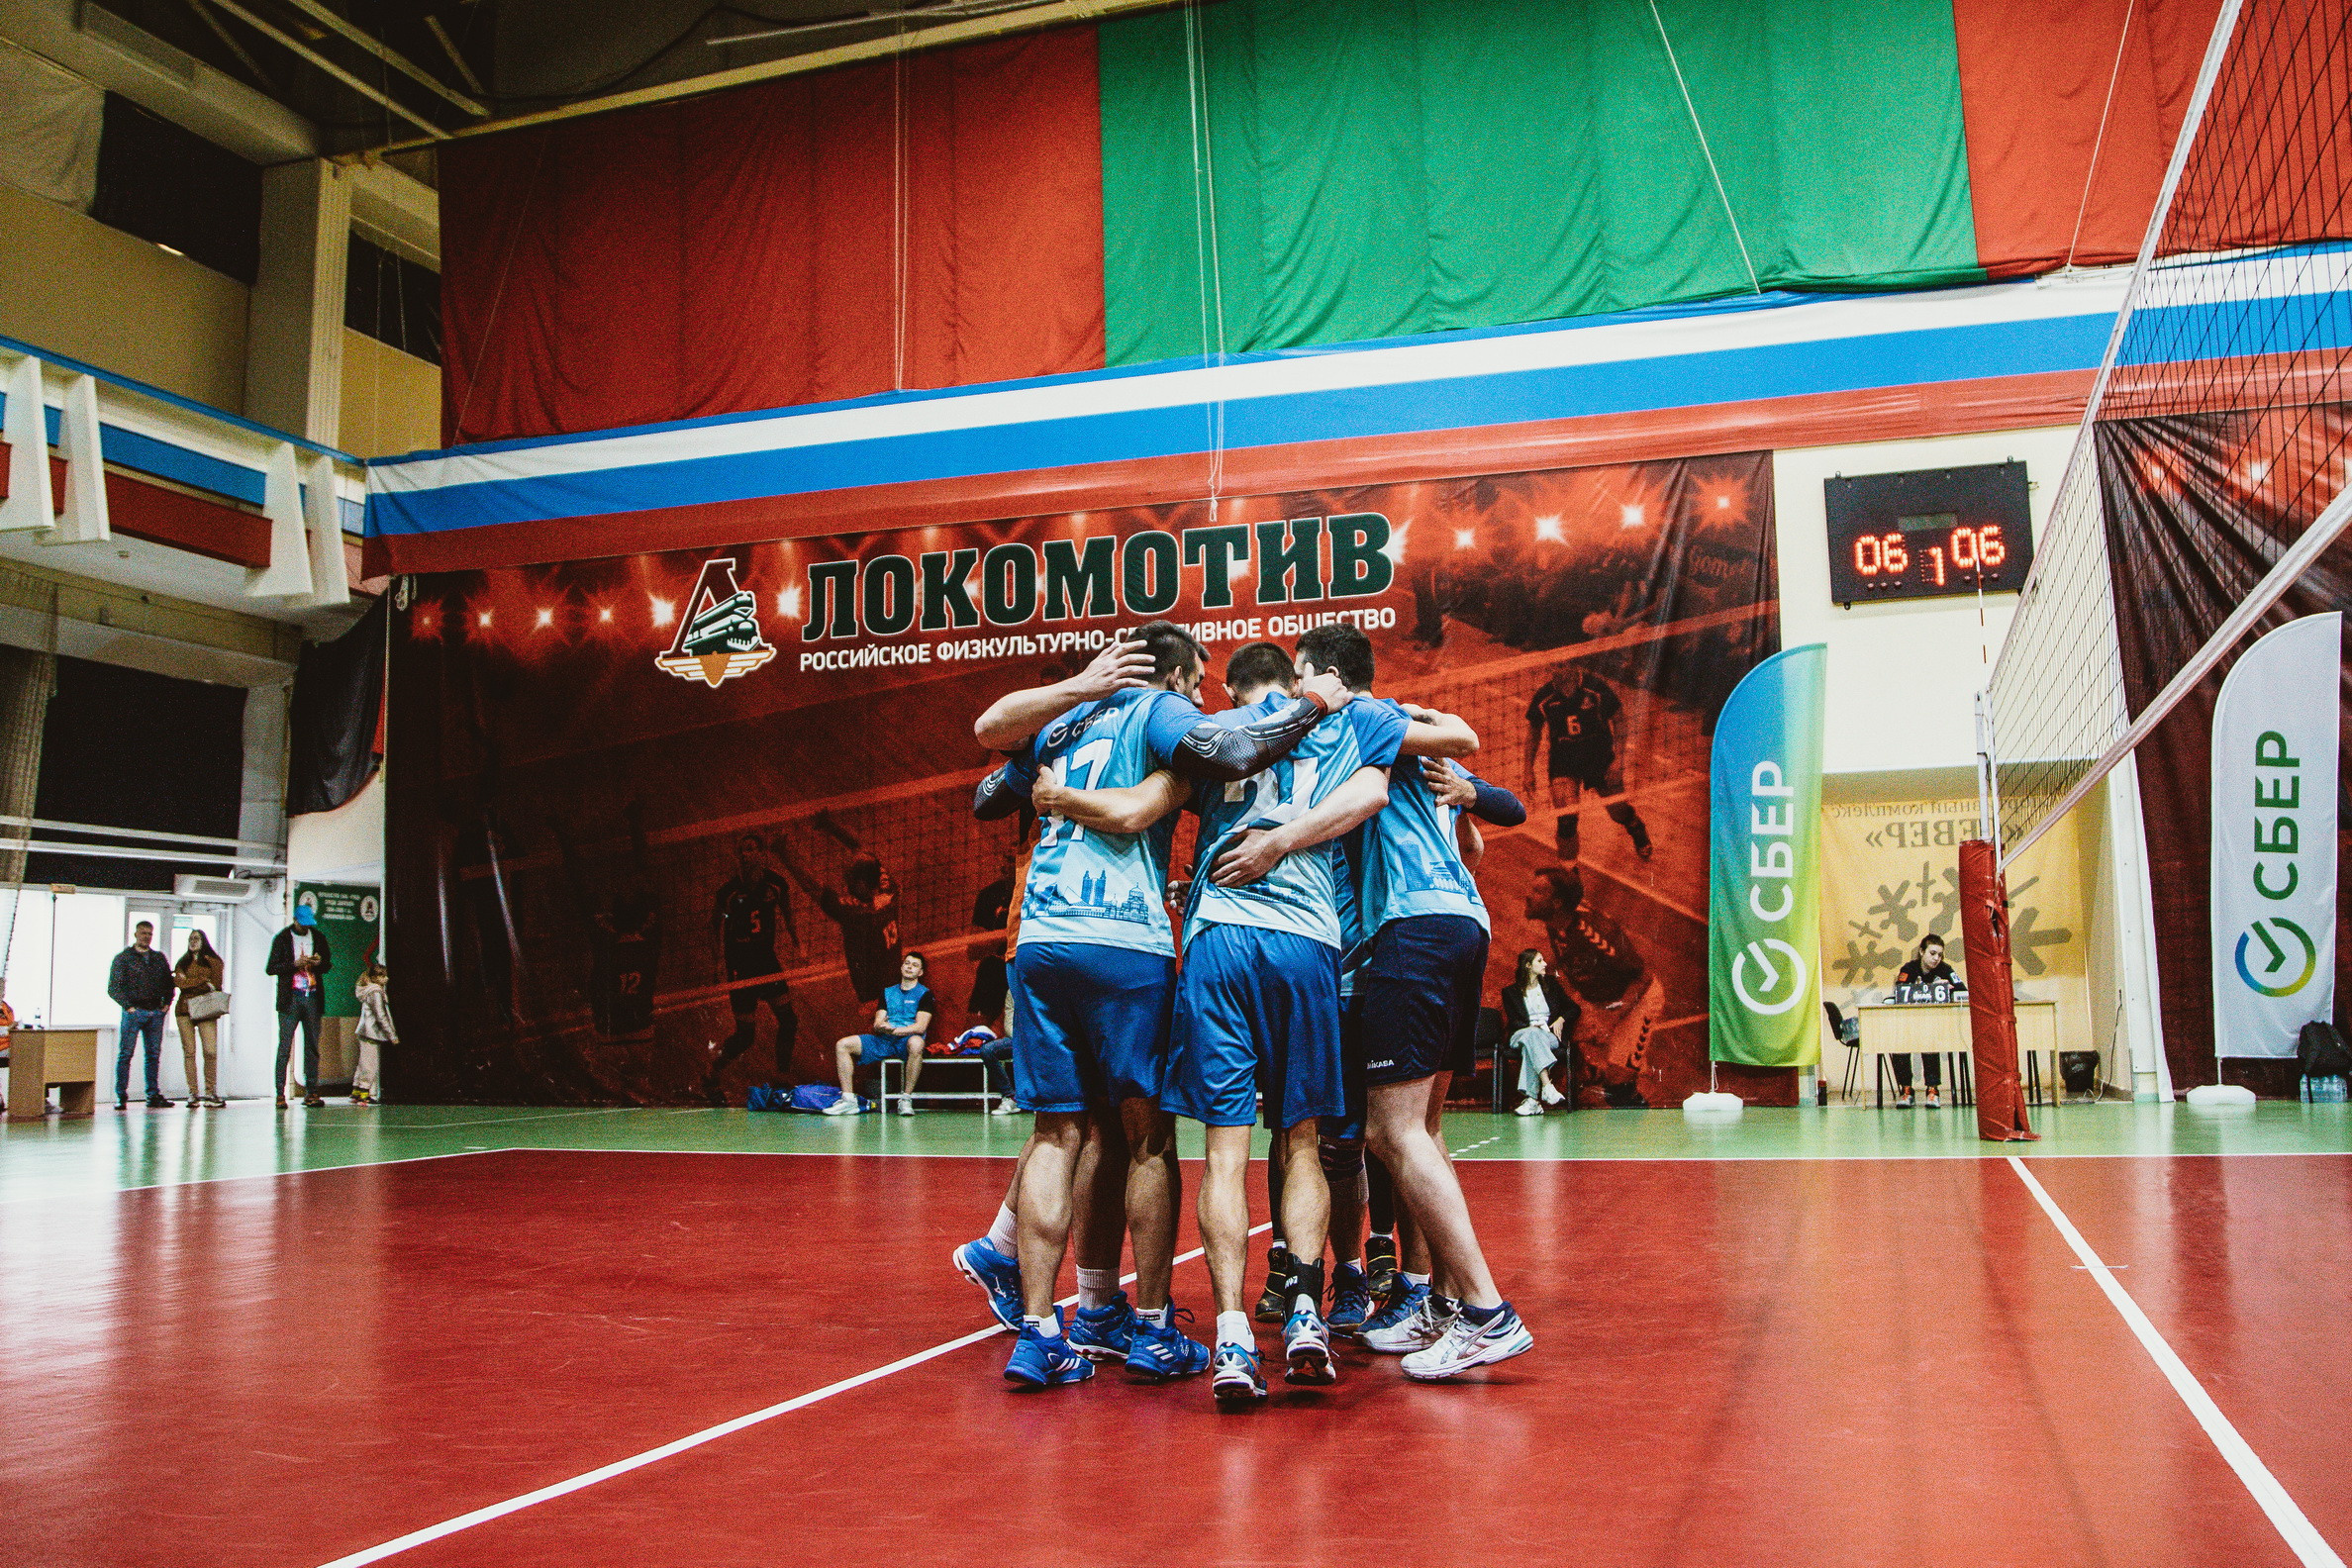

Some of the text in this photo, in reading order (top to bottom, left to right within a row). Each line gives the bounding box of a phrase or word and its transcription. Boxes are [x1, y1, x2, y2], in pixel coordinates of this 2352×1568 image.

[1854, 534, 1909, 576] 06
[1929, 546, 1945, 586] 1
[1951, 526, 2006, 568] 06
[802, 512, 1394, 641] ЛОКОМОТИВ
[800, 643, 931, 671] РОССИЙСКОЕ
[936, 617, 1262, 661] ФИЗКУЛЬТУРНО-СИВНОЕ
[1566, 715, 1582, 735] 6
[1038, 737, 1115, 848] 17
[2252, 731, 2301, 901] СБЕР
[1749, 760, 1795, 923] СБЕР
[1900, 985, 1911, 1003] 7
[1934, 985, 1946, 1002] 6
